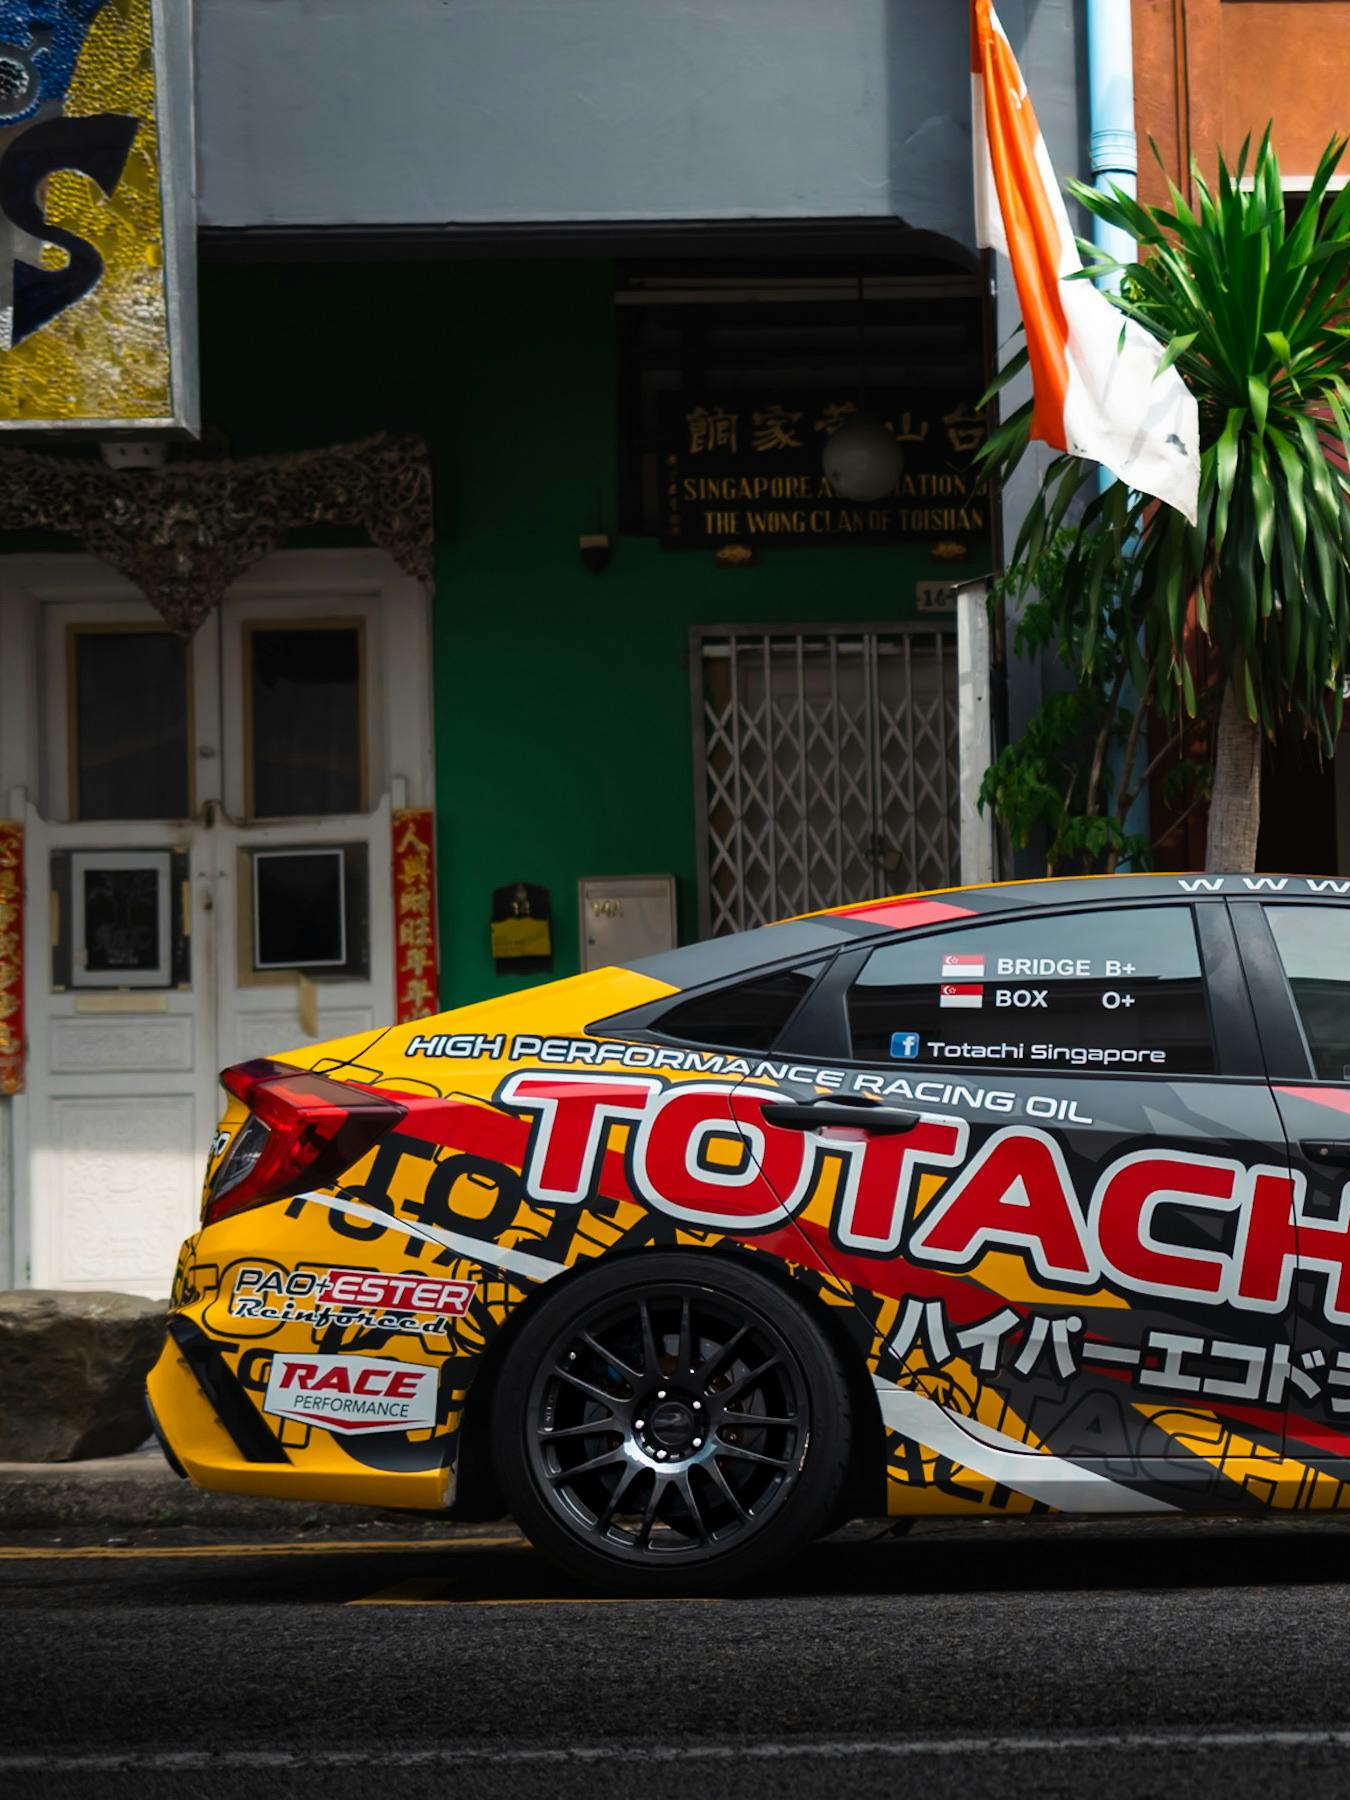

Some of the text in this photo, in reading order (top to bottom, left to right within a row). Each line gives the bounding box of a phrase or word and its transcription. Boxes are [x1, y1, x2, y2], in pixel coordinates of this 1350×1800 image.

[683, 475, 811, 500] SINGAPORE
[817, 474, 967, 498] AIATION
[704, 506, 984, 535] THE WONG CLAN OF TOISHAN
[997, 958, 1136, 977] BRIDGE B+
[995, 989, 1136, 1009] BOX O+
[927, 1042, 1024, 1059] Totachi
[1030, 1044, 1166, 1064] Singapore
[405, 1035, 1093, 1125] HIGH PERFORMANCE RACING OIL
[232, 1297, 448, 1336] Reinforced
[279, 1362, 426, 1399] RACE
[294, 1395, 410, 1418] PERFORMANCE
